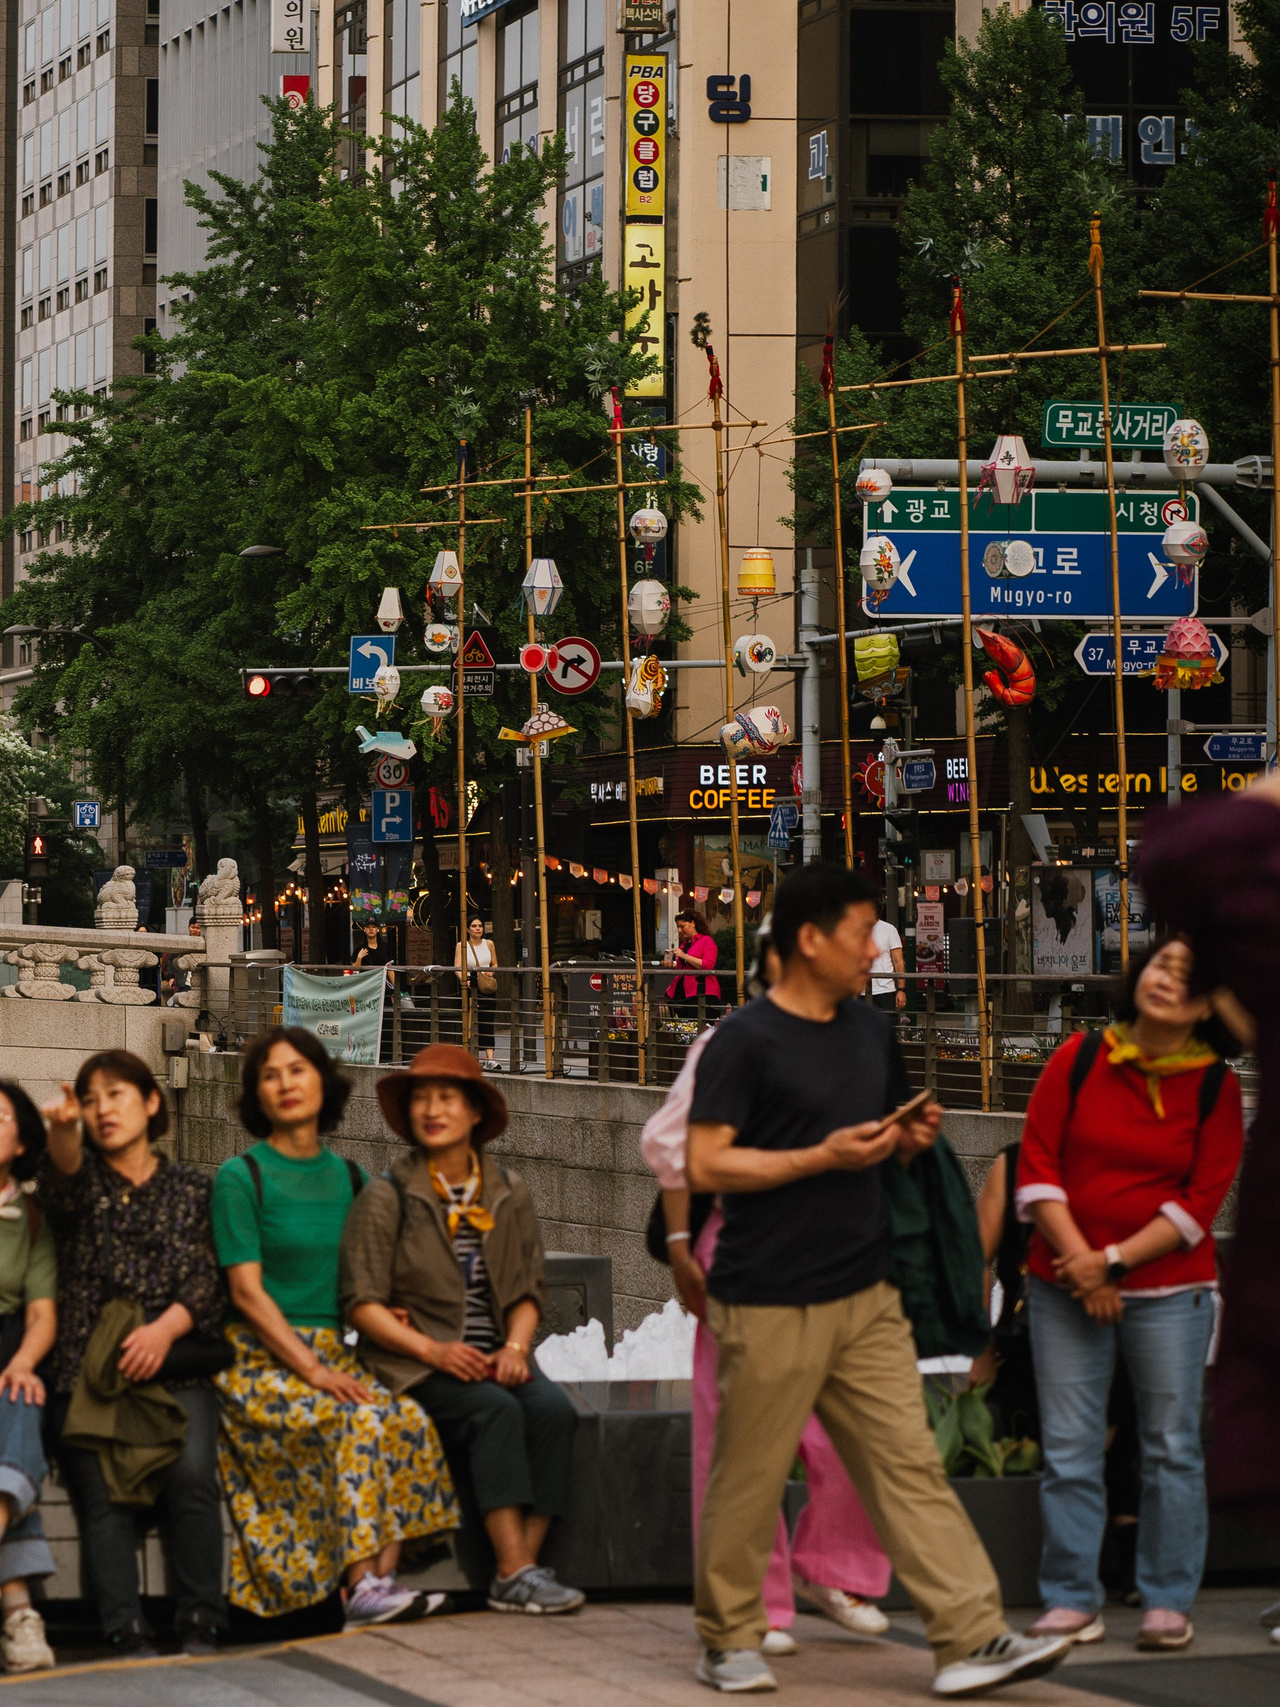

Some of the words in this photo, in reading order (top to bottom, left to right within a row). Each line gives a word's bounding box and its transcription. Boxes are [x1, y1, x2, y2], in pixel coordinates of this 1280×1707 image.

[626, 8, 661, 21] 텍사스바
[1171, 6, 1221, 42] 5F
[629, 65, 664, 79] PBA
[706, 73, 751, 123] 딩
[637, 84, 655, 188] 당구클럽
[639, 196, 653, 204] B2
[628, 243, 662, 354] 고바우
[905, 499, 951, 524] 광교
[1116, 502, 1158, 526] 시청
[990, 587, 1073, 606] Mugyo-ro
[1088, 648, 1104, 661] 37
[1127, 640, 1166, 655] 무교
[463, 675, 489, 683] 회전시
[382, 765, 402, 779] 30
[700, 764, 767, 785] BEER
[385, 792, 400, 814] P
[689, 789, 776, 809] COFFEE
[1106, 892, 1132, 903] DER
[1037, 955, 1068, 968] 버지니아
[1071, 955, 1087, 972] 울프
